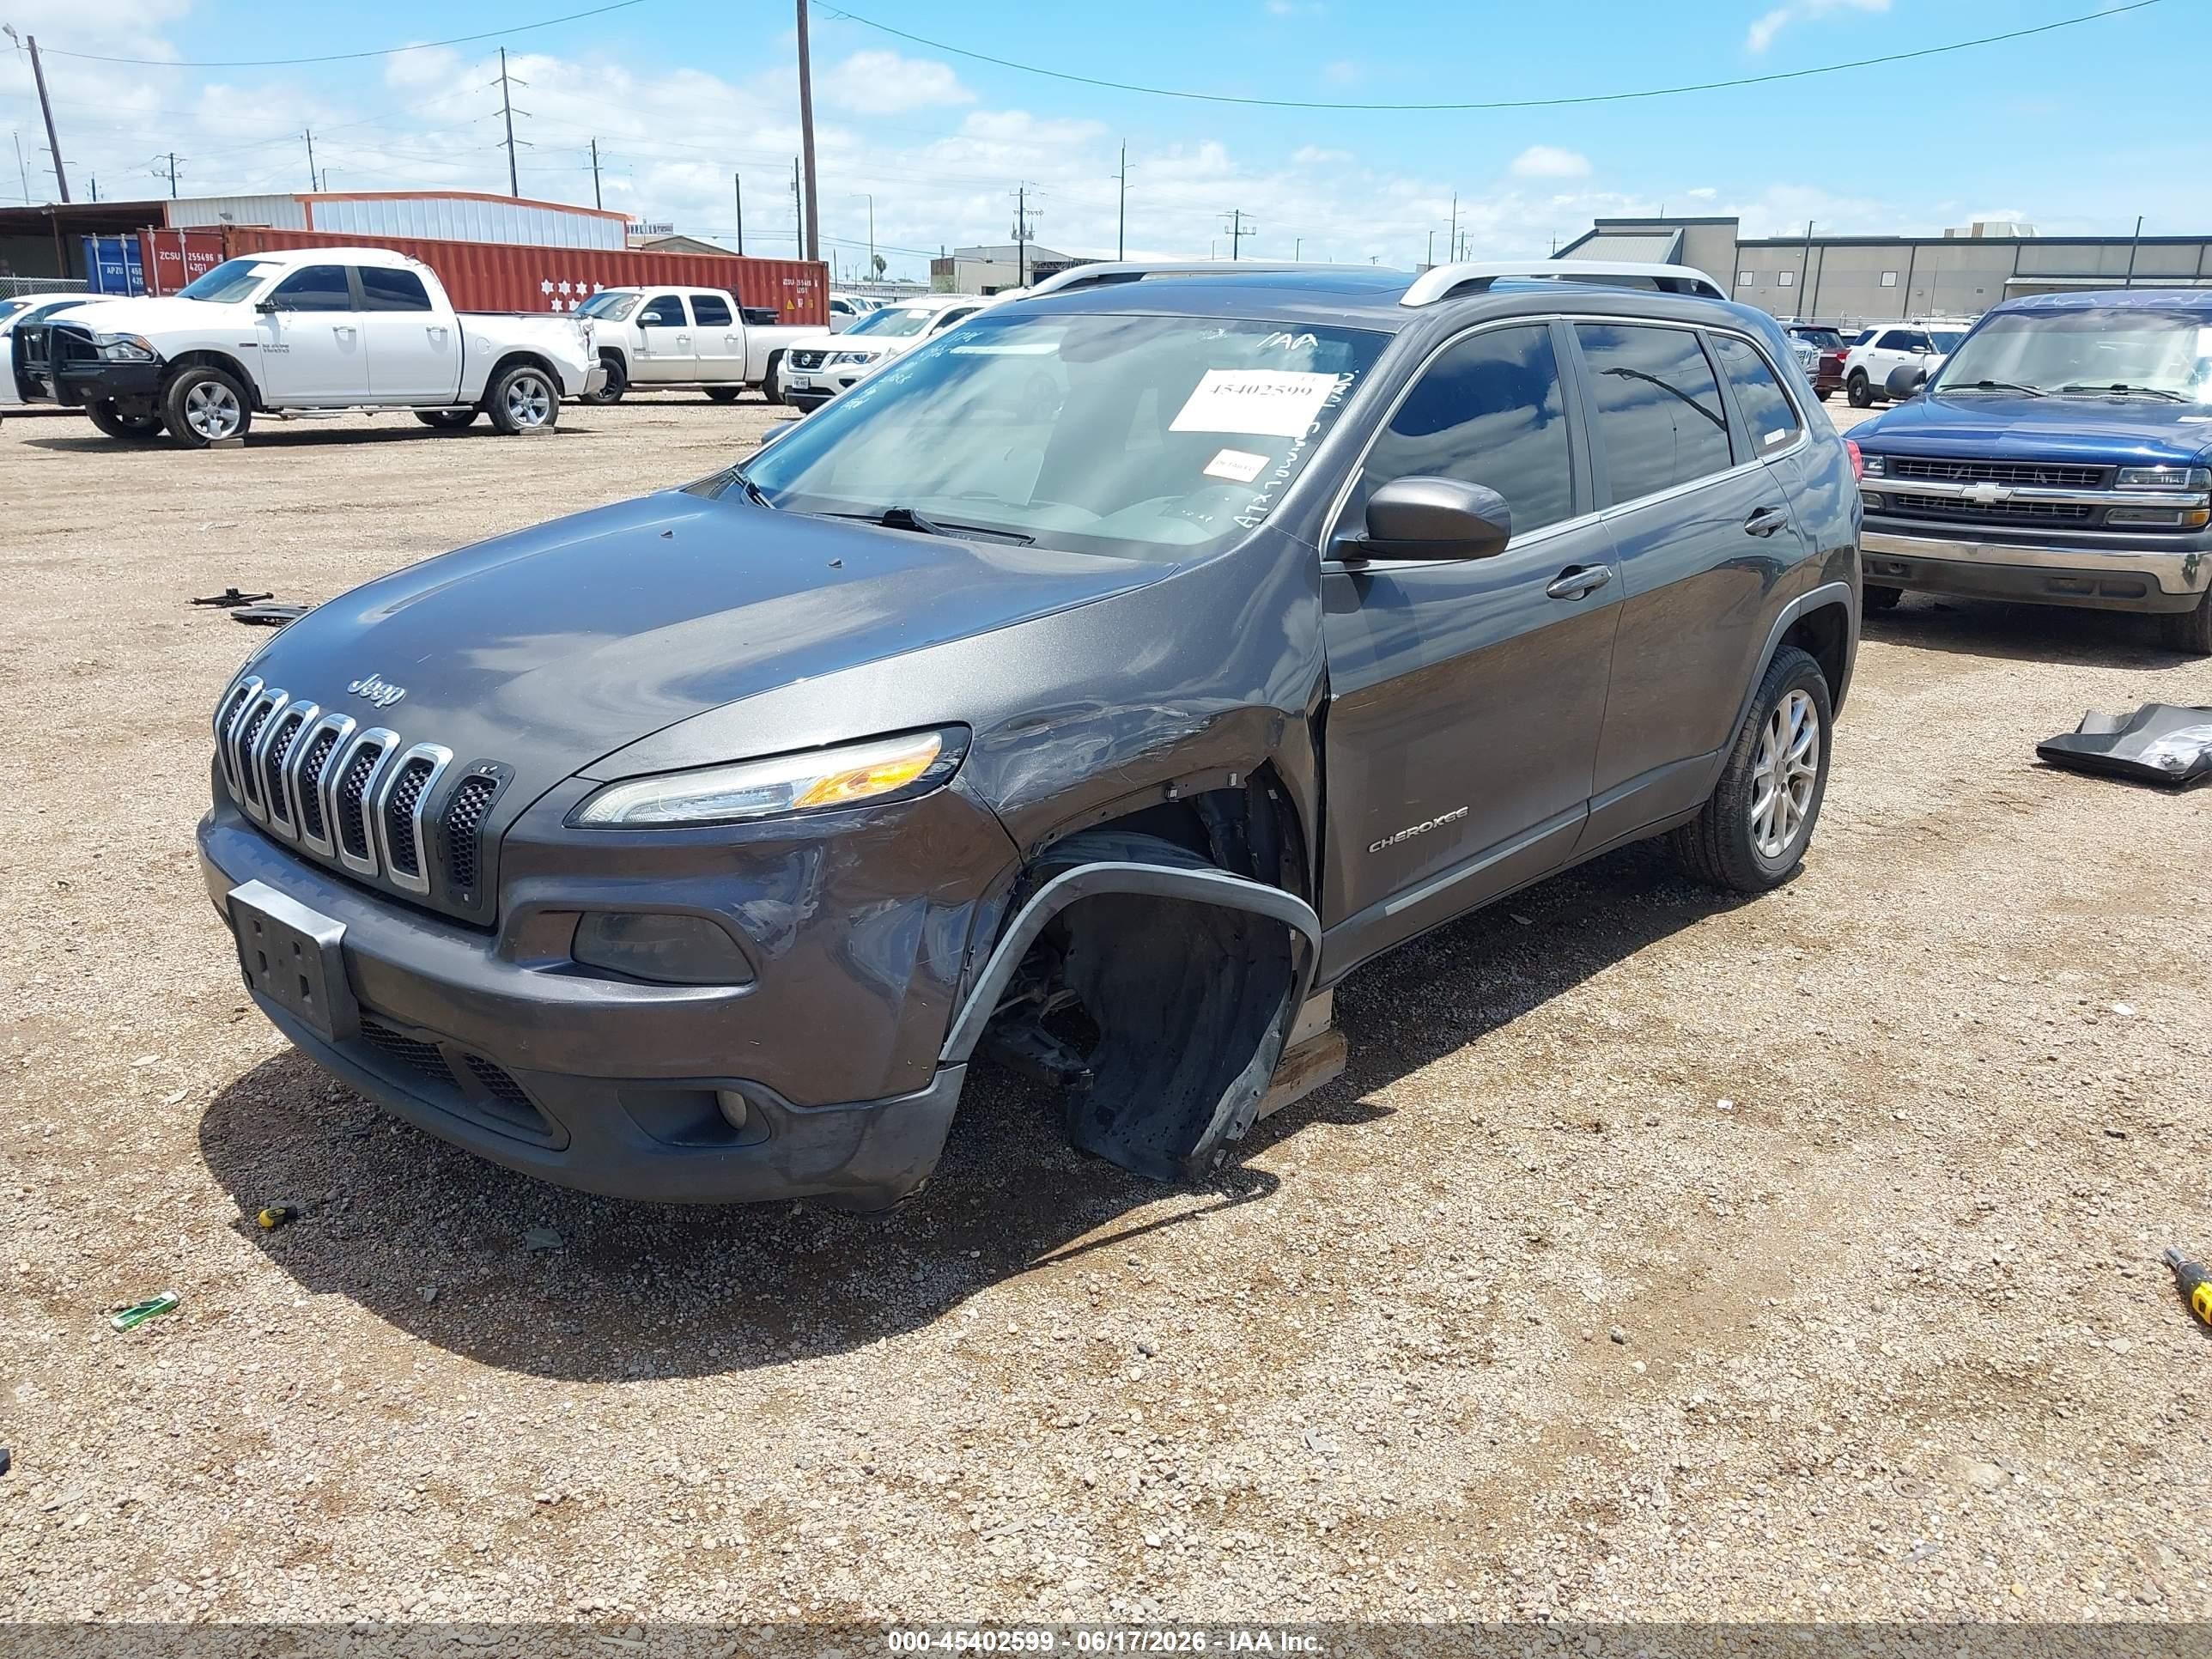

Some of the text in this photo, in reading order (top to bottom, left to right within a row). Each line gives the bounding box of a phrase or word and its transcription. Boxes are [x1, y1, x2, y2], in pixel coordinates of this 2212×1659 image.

[160, 252, 180, 261] ZCSU
[187, 252, 214, 262] 255496
[106, 266, 124, 275] APZU
[189, 263, 207, 272] 42G1
[1256, 331, 1319, 350] IAA
[347, 673, 405, 708] Jeep
[1368, 805, 1469, 853] CHEROKEE
